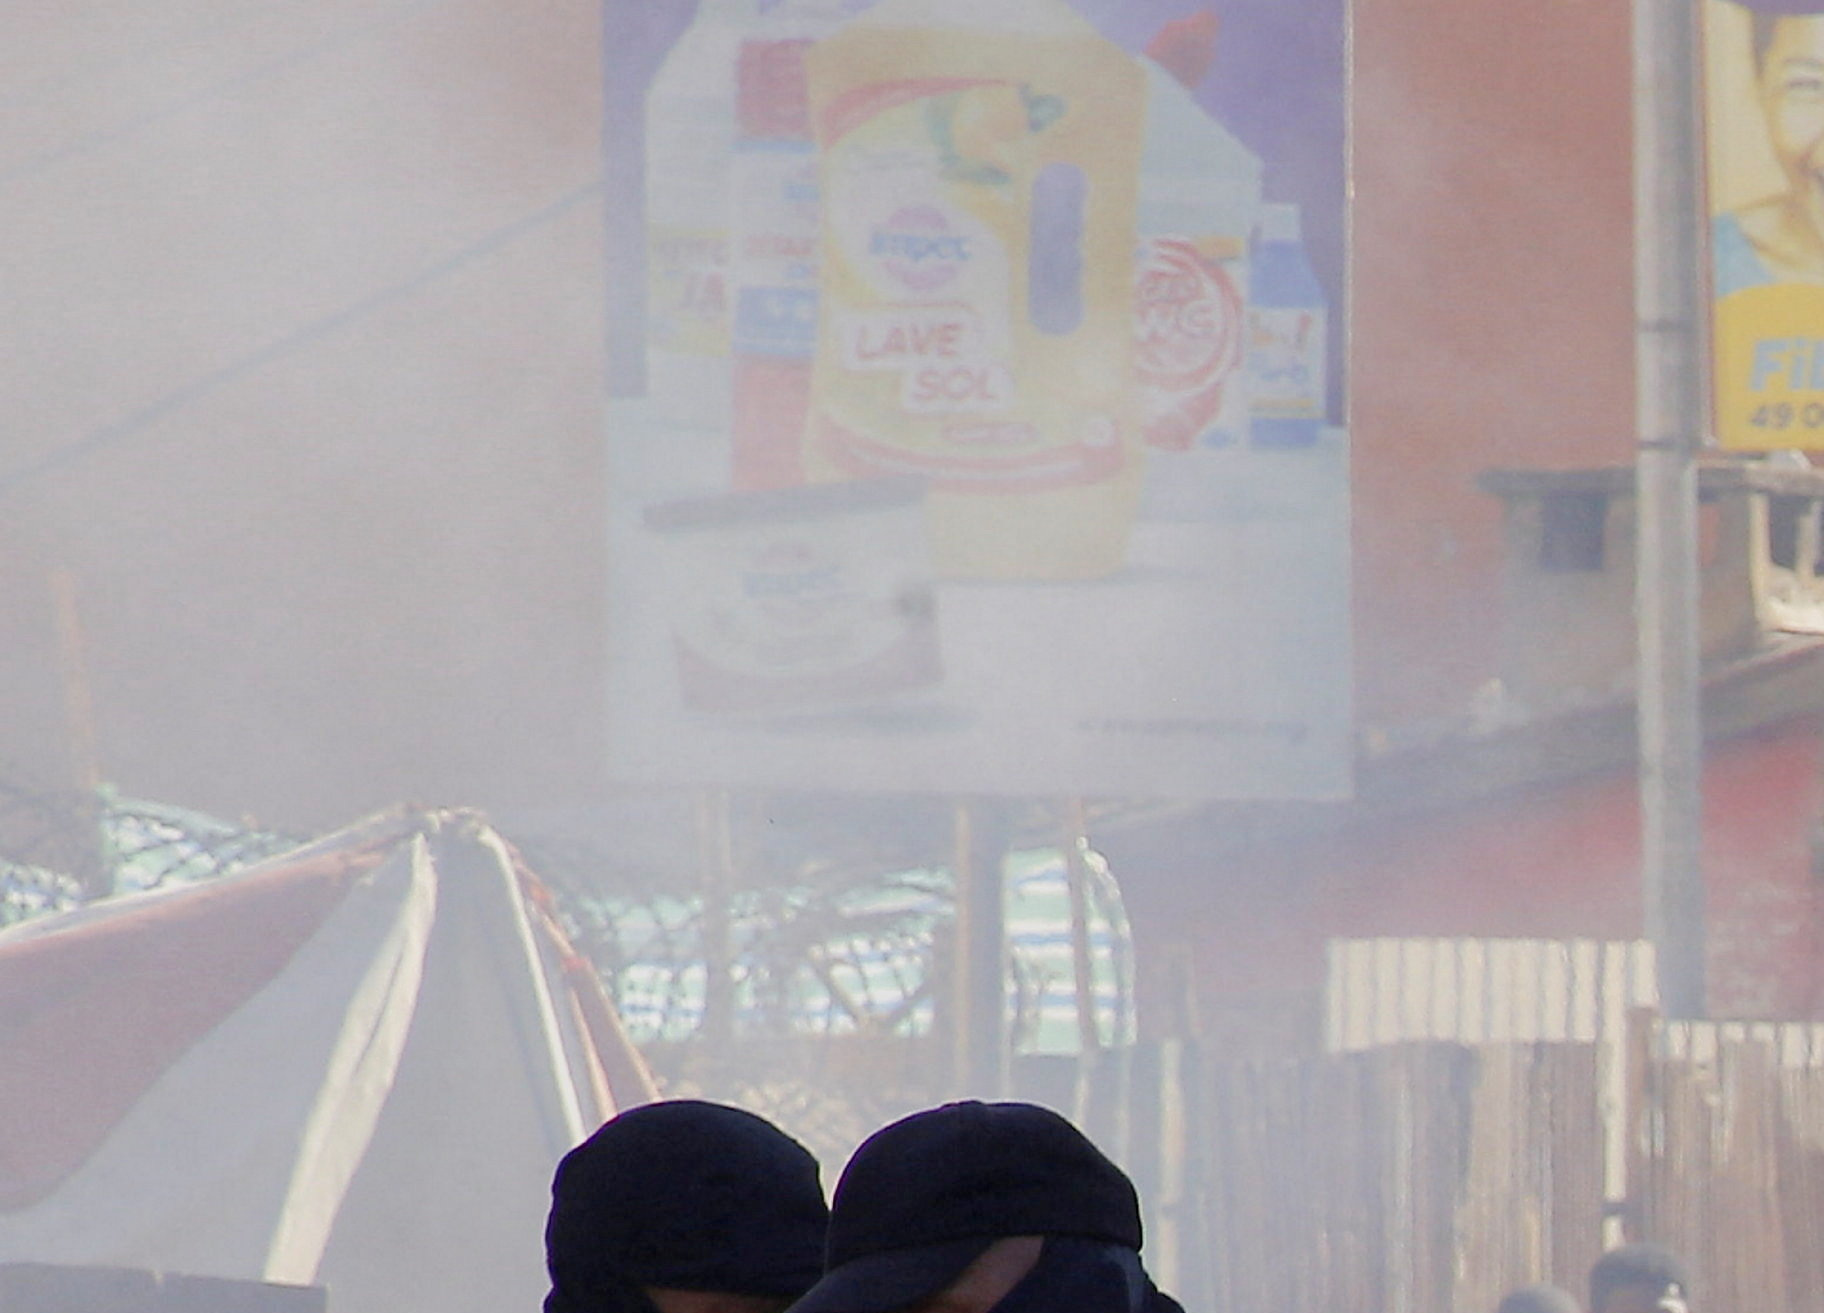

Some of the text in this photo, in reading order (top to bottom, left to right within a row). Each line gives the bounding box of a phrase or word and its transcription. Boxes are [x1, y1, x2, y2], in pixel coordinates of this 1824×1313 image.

[855, 322, 964, 360] LAVE
[912, 366, 996, 400] SOL
[1751, 402, 1794, 429] 49
